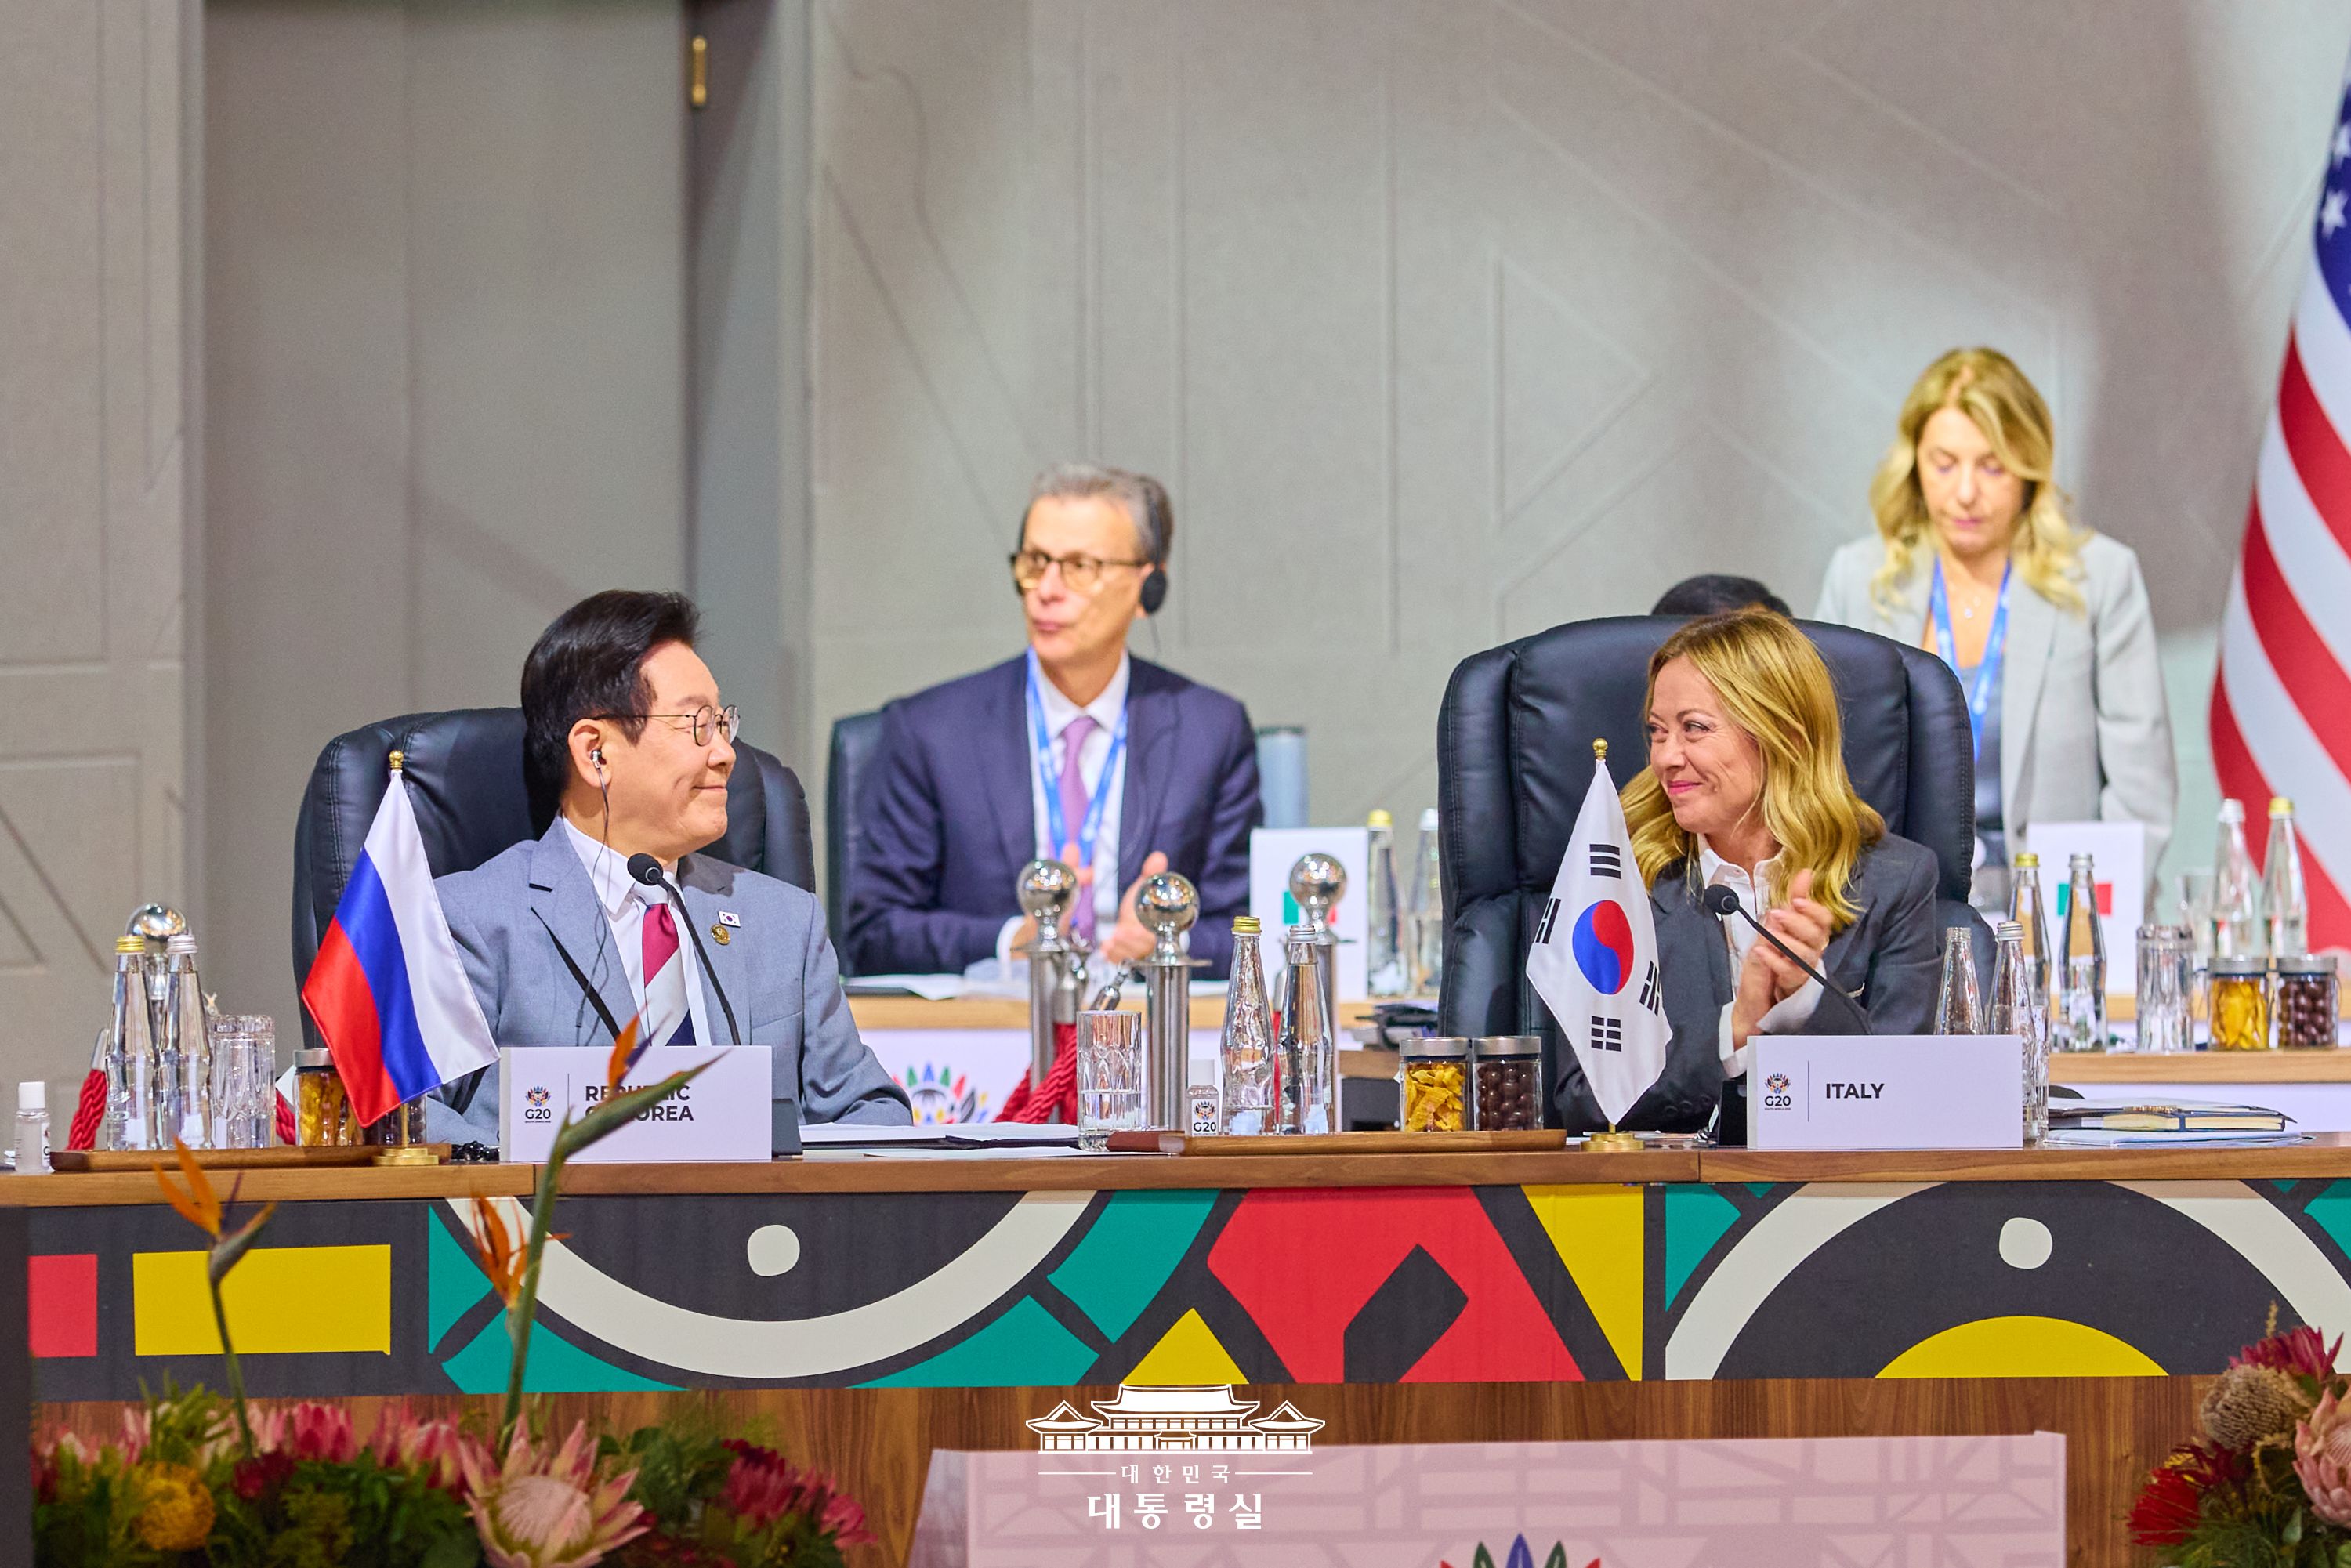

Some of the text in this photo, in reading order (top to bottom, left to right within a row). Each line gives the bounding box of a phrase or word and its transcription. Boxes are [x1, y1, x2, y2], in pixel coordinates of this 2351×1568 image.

[1826, 1083, 1885, 1099] ITALY
[1764, 1095, 1791, 1106] G20
[525, 1108, 551, 1120] G20
[1193, 1121, 1217, 1132] G20
